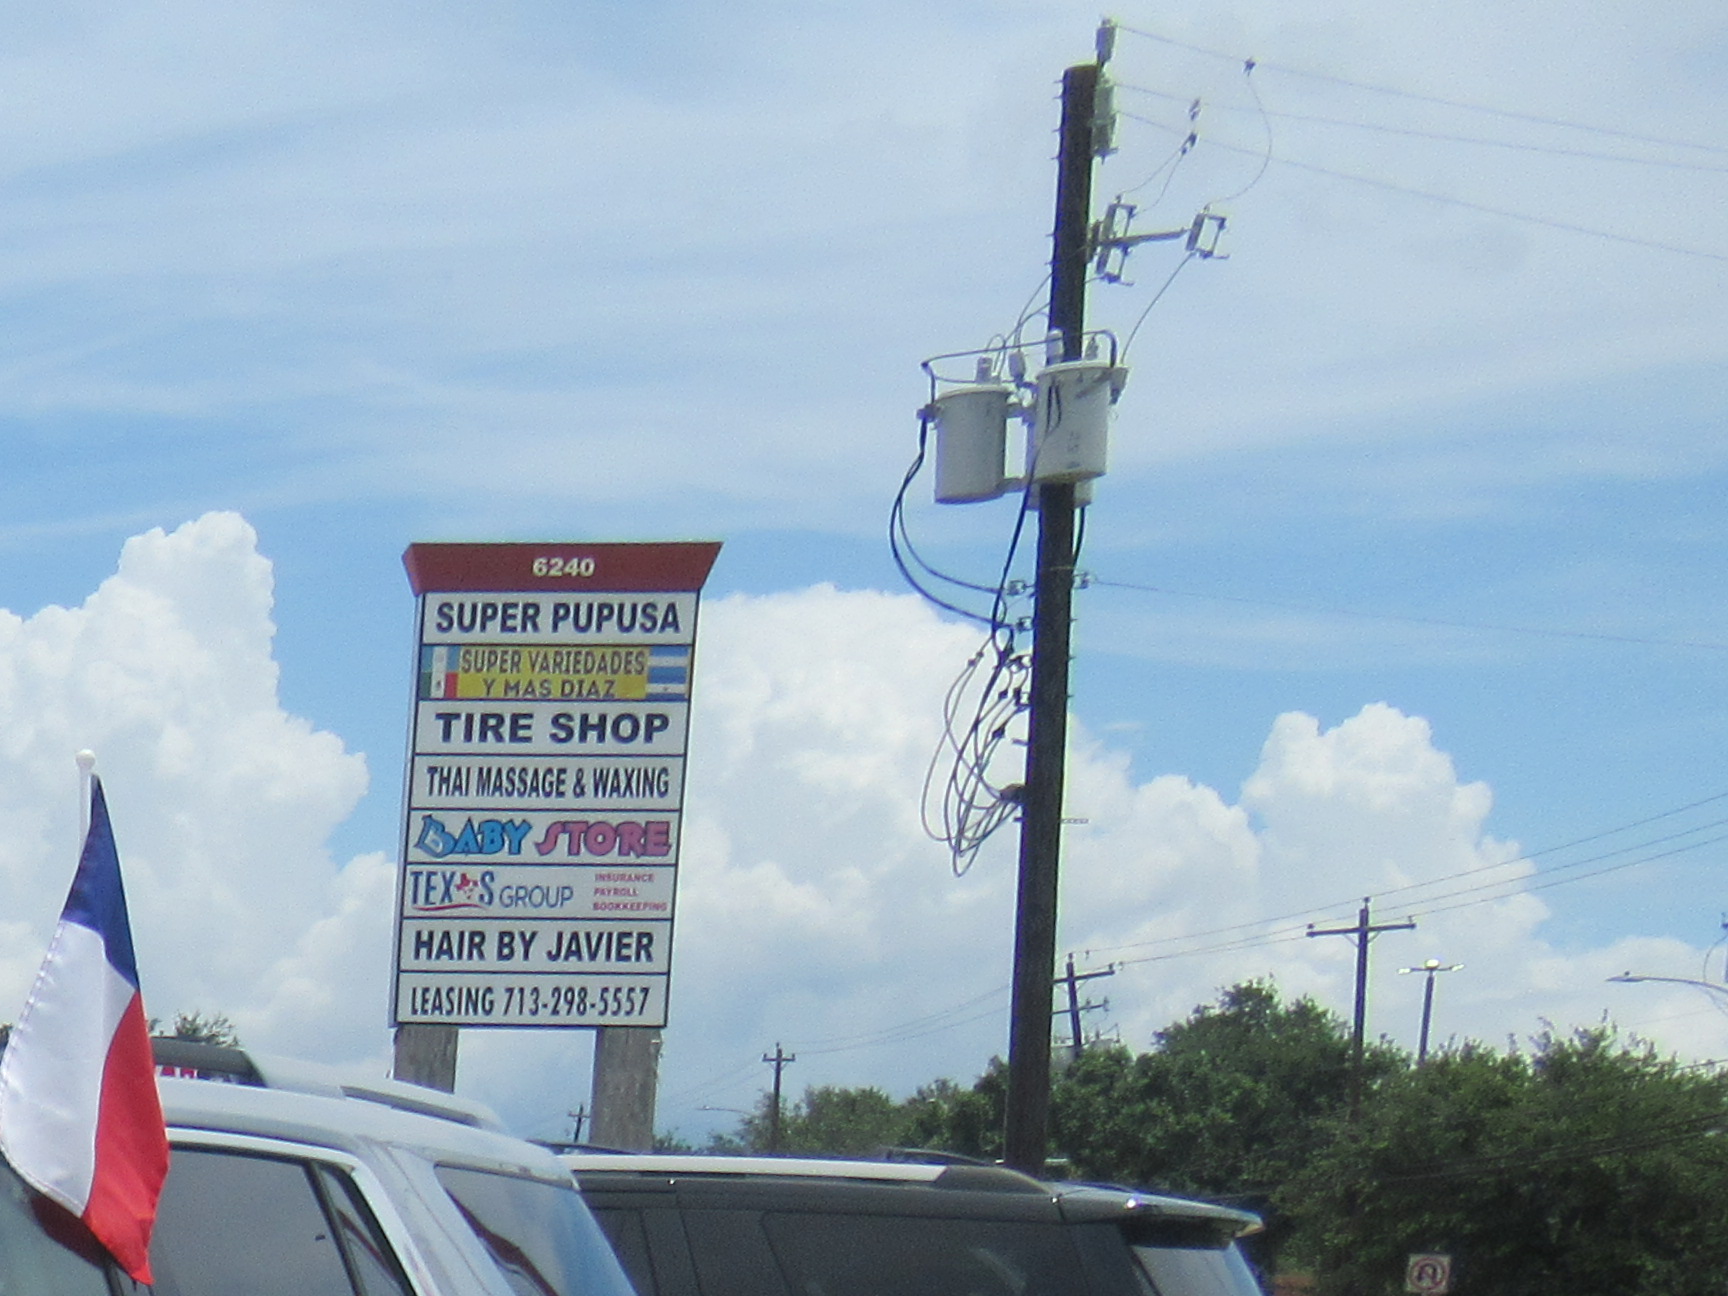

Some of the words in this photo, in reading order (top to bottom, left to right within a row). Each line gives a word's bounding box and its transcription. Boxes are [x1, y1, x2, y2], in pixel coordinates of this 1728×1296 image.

[532, 557, 595, 577] 6240
[435, 602, 540, 633] SUPER
[551, 602, 681, 633] PUPUSA
[461, 650, 523, 674] SUPER
[526, 650, 645, 675] VARIEDADES
[482, 679, 497, 697] Y
[503, 679, 552, 698] MAS
[560, 679, 616, 698] DIAZ
[435, 713, 534, 743] TIRE
[549, 713, 669, 744] SHOP
[427, 767, 470, 797] THAI
[476, 767, 566, 798] MASSAGE
[573, 770, 586, 797] &
[592, 767, 669, 798] WAXING
[414, 814, 532, 859] BABY
[535, 821, 672, 857] STORE
[595, 873, 655, 883] INSURANCE
[500, 886, 574, 908] GROUP
[594, 887, 639, 897] PAYROLL
[593, 902, 668, 911] BOOKKEEPING
[413, 930, 486, 961] HAIR
[496, 931, 538, 961] BY
[546, 931, 654, 962] JAVIER
[410, 986, 494, 1016] LEASING
[503, 986, 651, 1017] 713-298-5557
